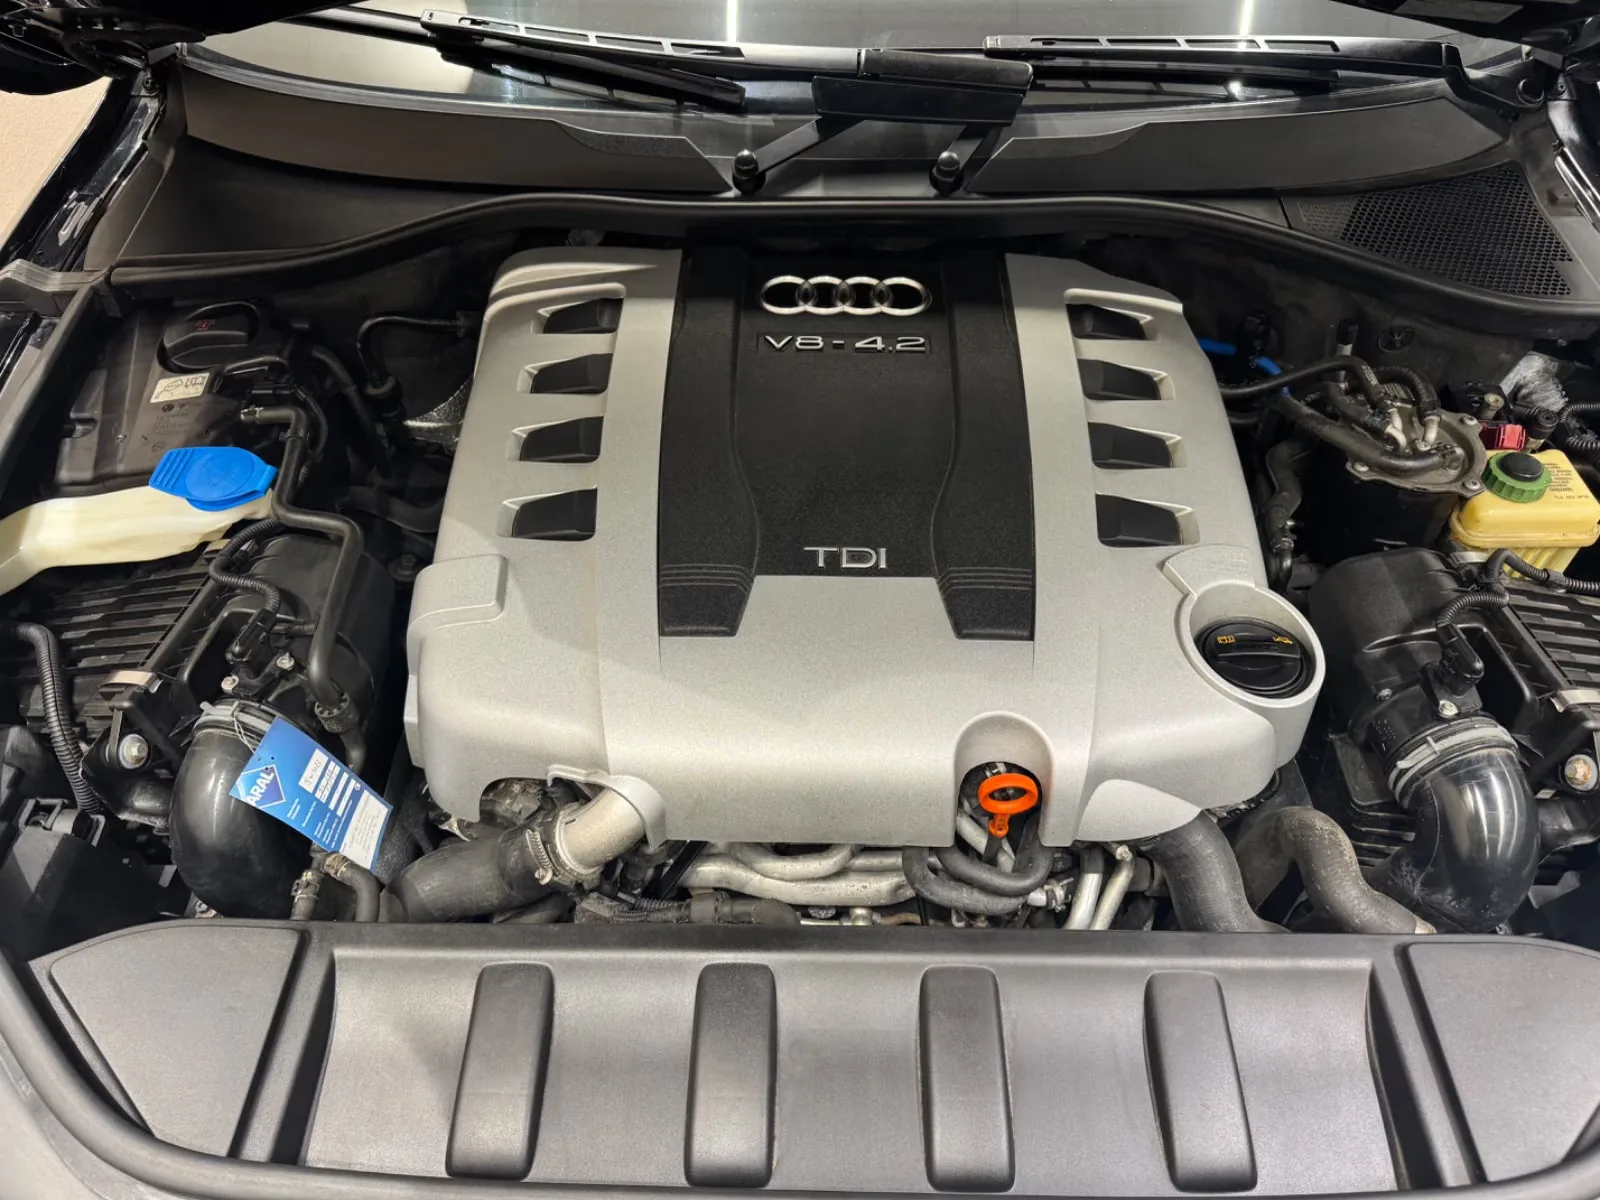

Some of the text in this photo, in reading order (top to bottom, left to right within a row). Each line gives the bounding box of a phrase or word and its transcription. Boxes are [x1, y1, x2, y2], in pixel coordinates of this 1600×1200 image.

[765, 335, 824, 350] V8
[855, 335, 926, 351] 4.2
[803, 546, 887, 569] TDI
[246, 771, 275, 806] ARAL
